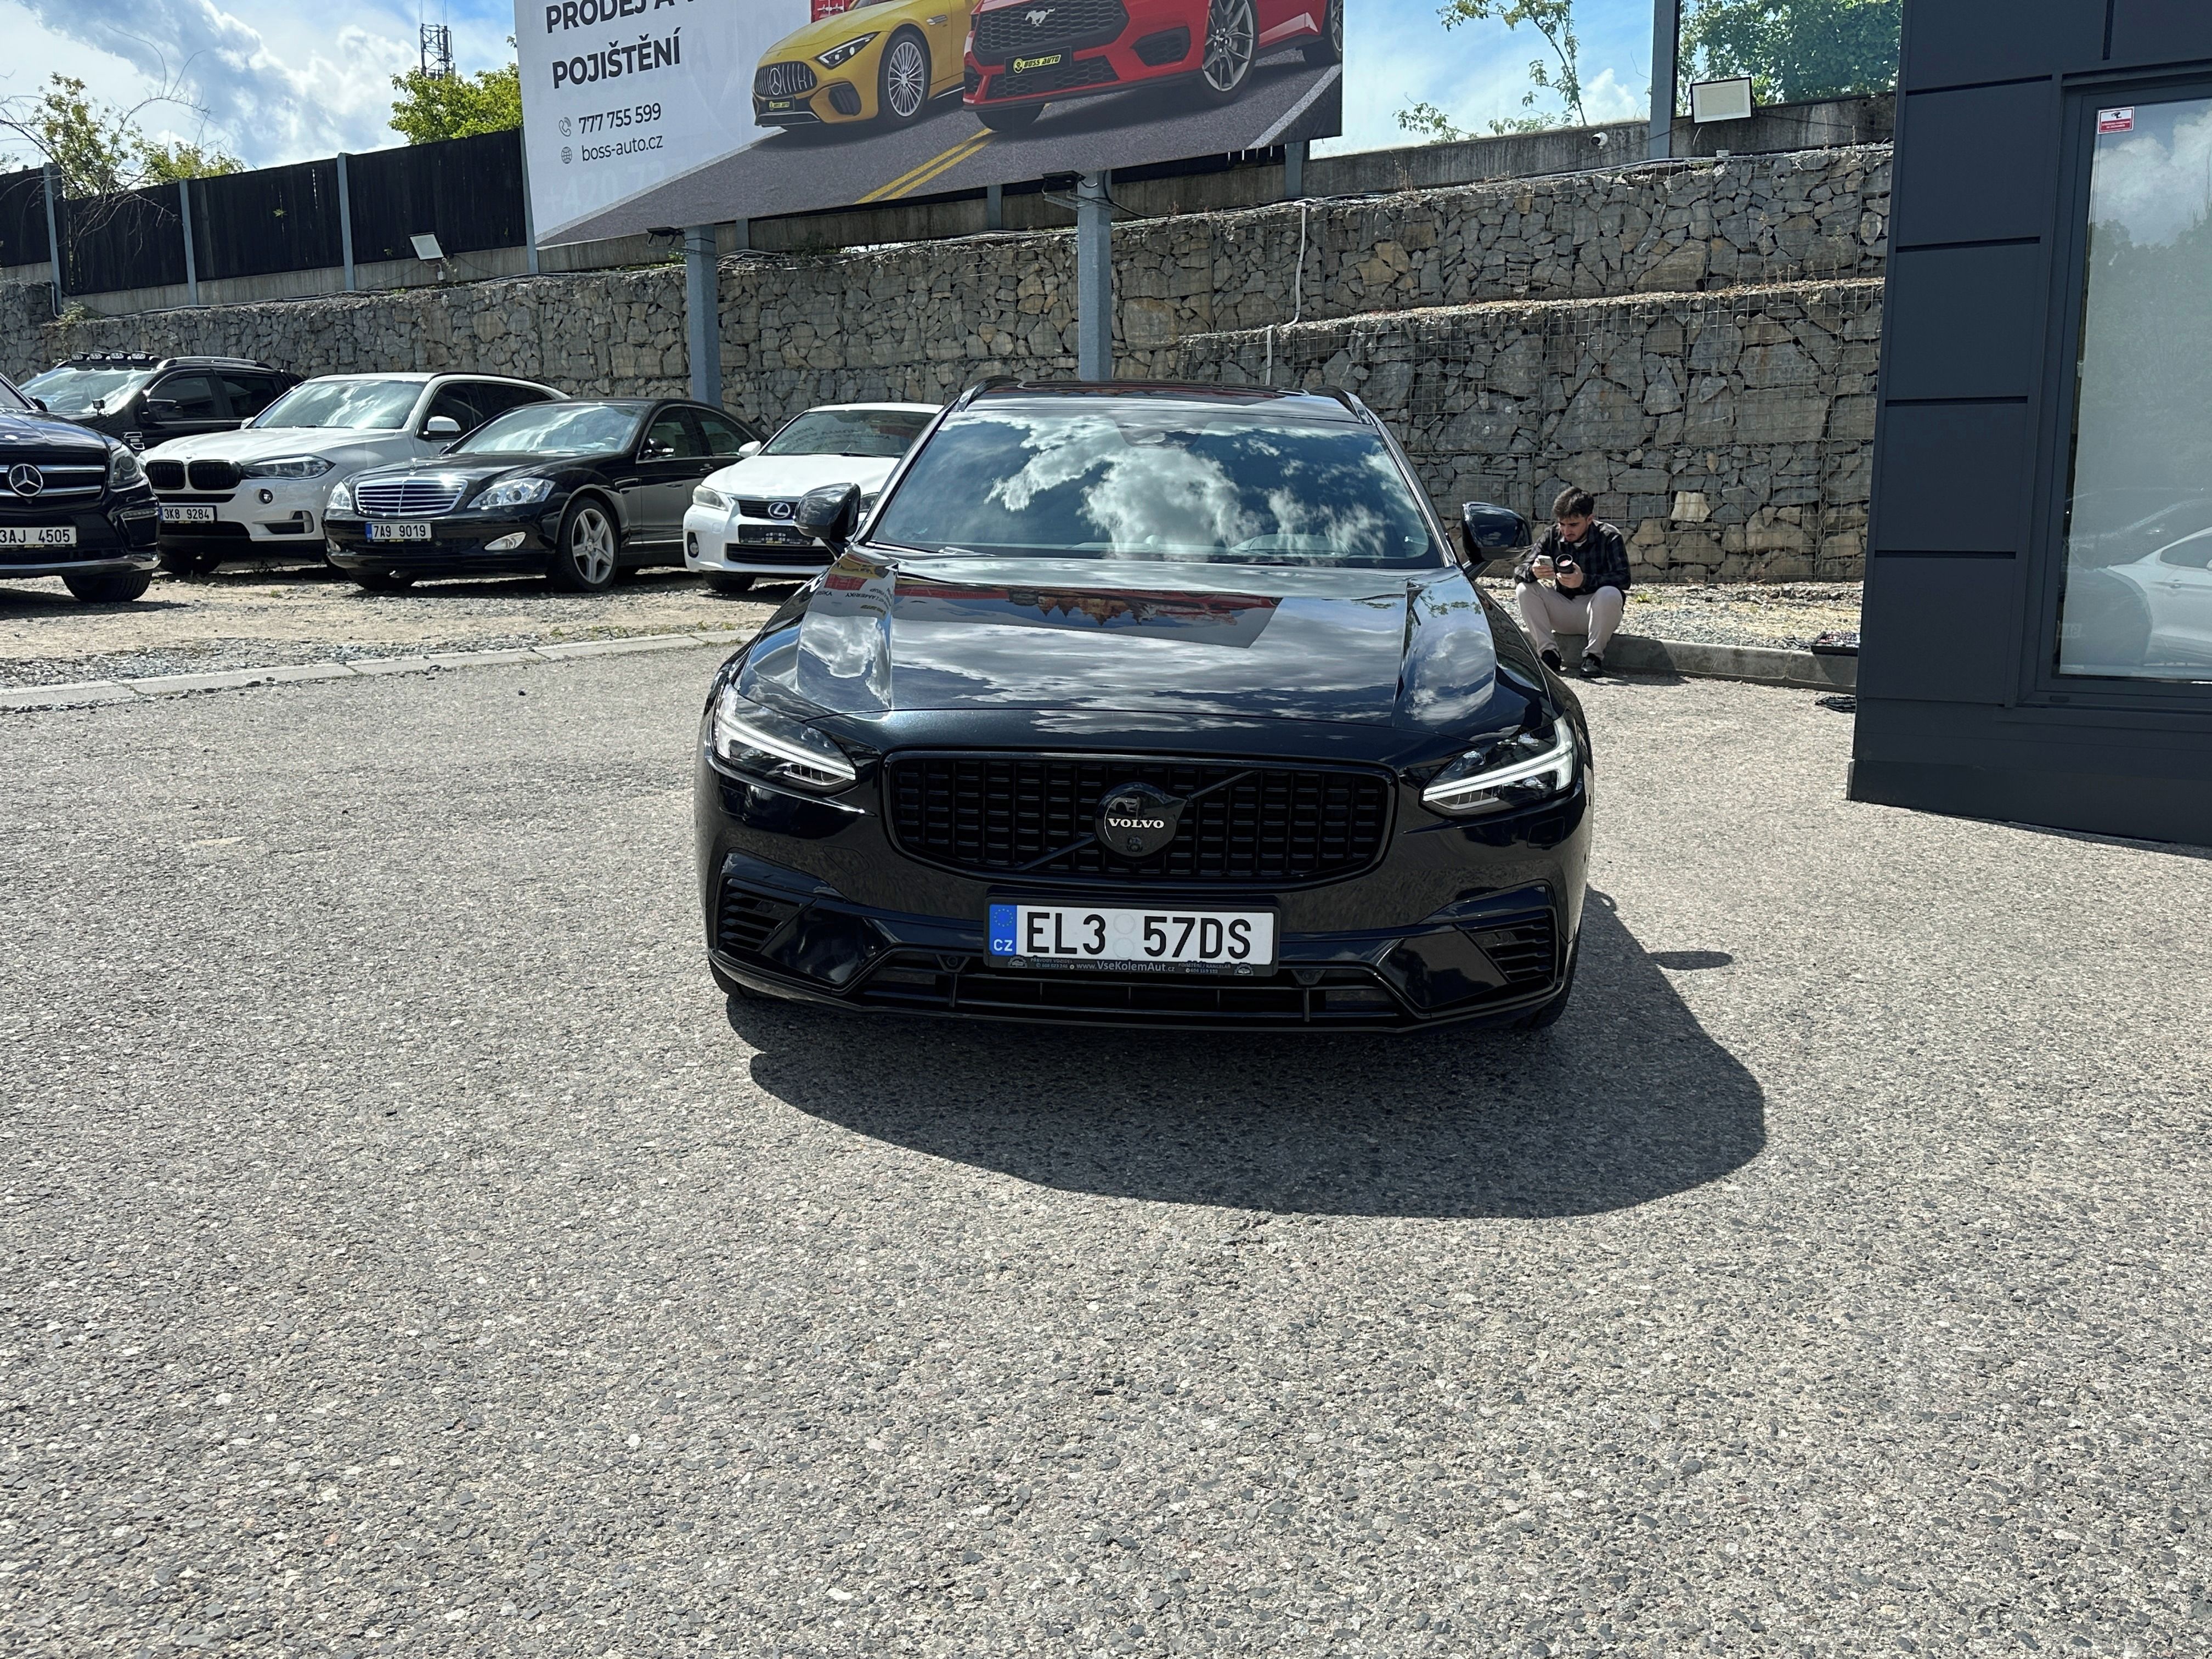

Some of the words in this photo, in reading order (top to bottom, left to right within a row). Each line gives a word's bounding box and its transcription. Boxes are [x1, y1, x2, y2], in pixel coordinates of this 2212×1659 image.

[552, 27, 681, 88] POJIŠTĚNÍ
[579, 114, 603, 134] 777
[607, 108, 631, 128] 755
[635, 103, 661, 123] 599
[582, 136, 663, 161] boss-auto.cz
[165, 509, 180, 519] 3K8
[187, 509, 209, 519] 9284
[0, 529, 26, 543] 3AJ
[38, 529, 70, 543] 4505
[374, 526, 391, 538] 7A9
[399, 525, 426, 537] 9019
[1107, 818, 1164, 828] VOLVO
[1027, 911, 1106, 955] EL3
[1144, 916, 1251, 959] 57DS
[994, 939, 1013, 952] CZ
